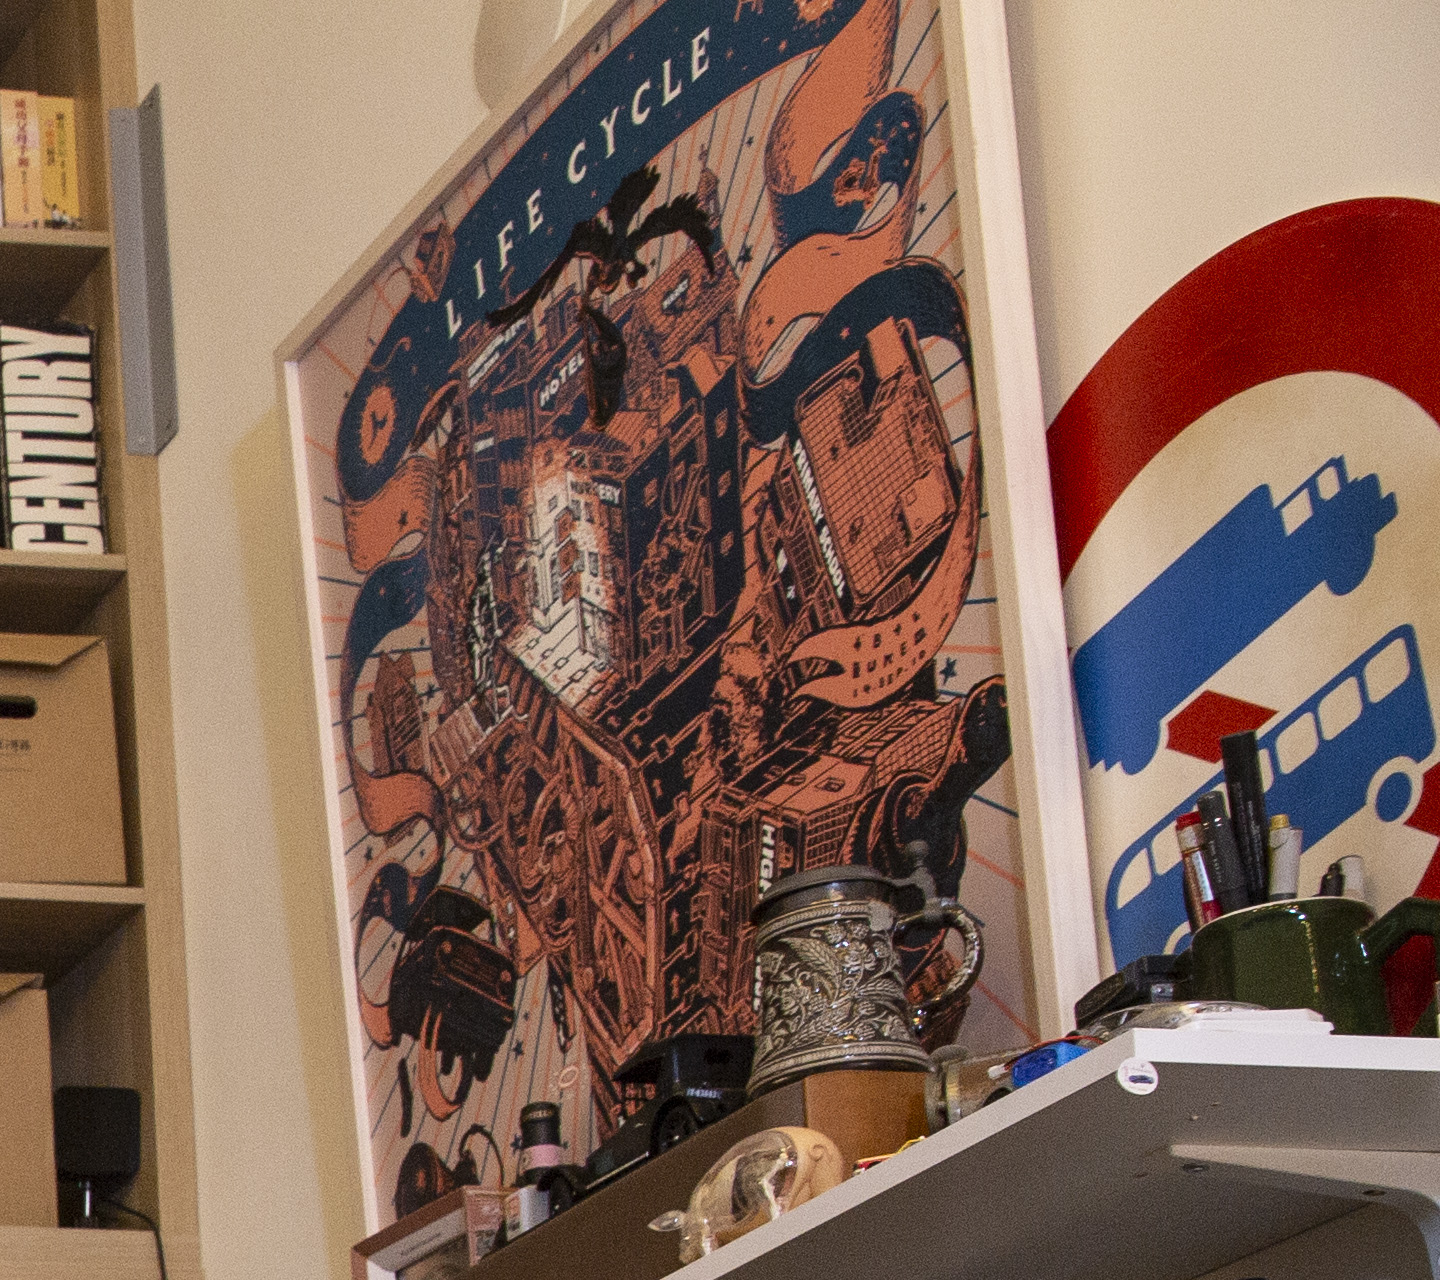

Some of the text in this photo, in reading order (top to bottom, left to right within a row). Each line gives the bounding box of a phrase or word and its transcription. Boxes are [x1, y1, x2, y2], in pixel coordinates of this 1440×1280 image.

[445, 186, 544, 341] LIFE
[566, 26, 711, 186] CYCLE
[0, 325, 105, 551] CENTURY
[539, 351, 586, 408] HOTEL
[792, 438, 845, 599] PRIMARY SCHOOL
